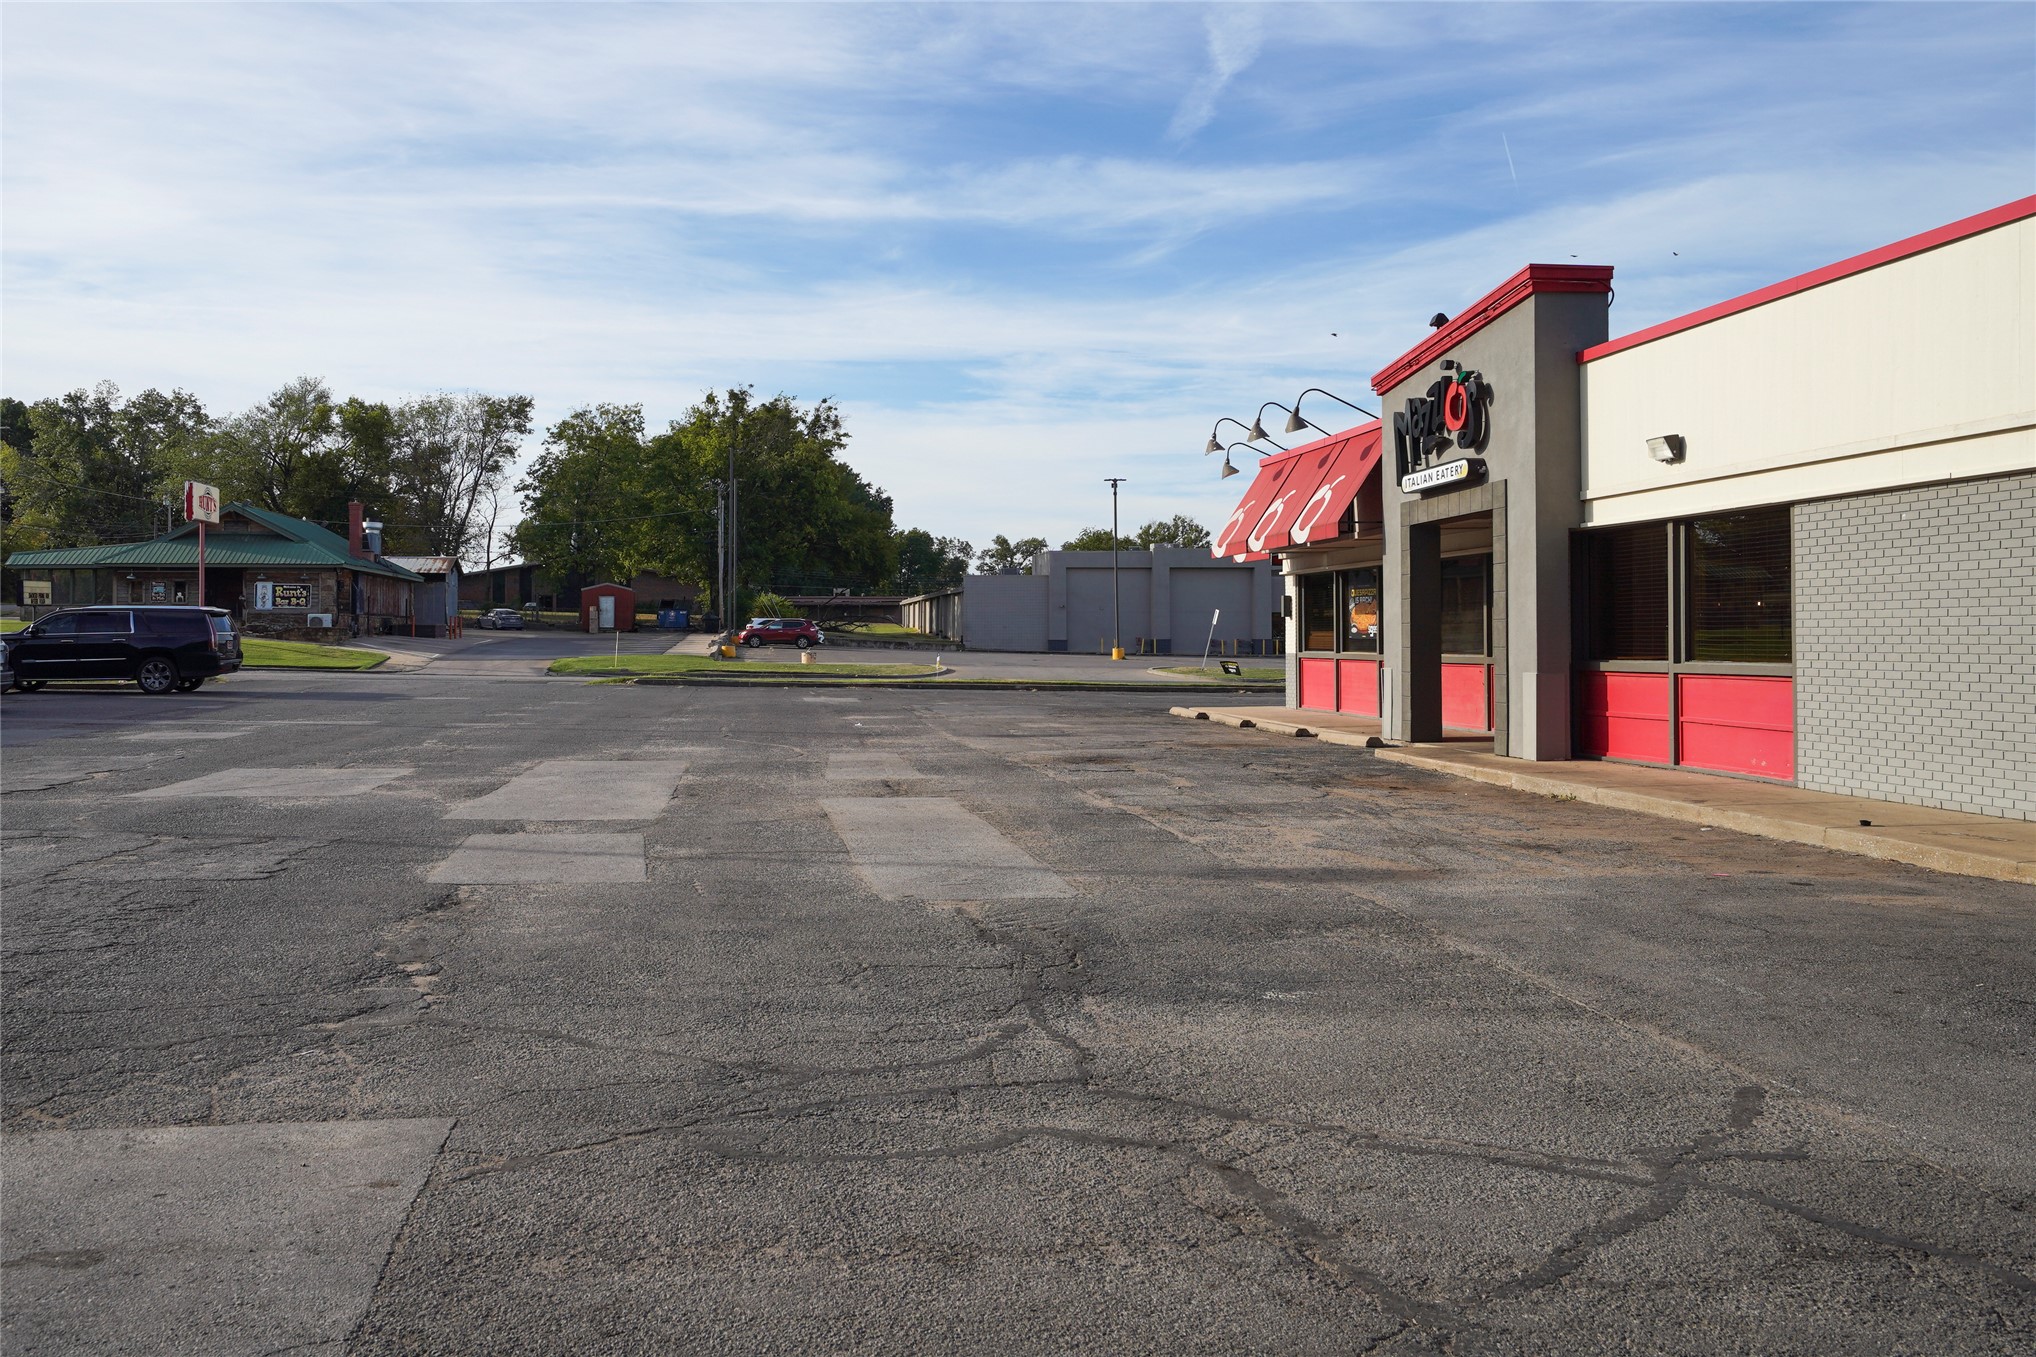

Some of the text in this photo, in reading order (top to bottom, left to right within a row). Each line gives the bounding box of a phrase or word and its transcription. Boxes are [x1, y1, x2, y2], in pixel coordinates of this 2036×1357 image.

[1404, 463, 1465, 489] ITALIAN EATERY
[275, 586, 307, 597] Runt's
[275, 597, 306, 606] Bar B-Q
